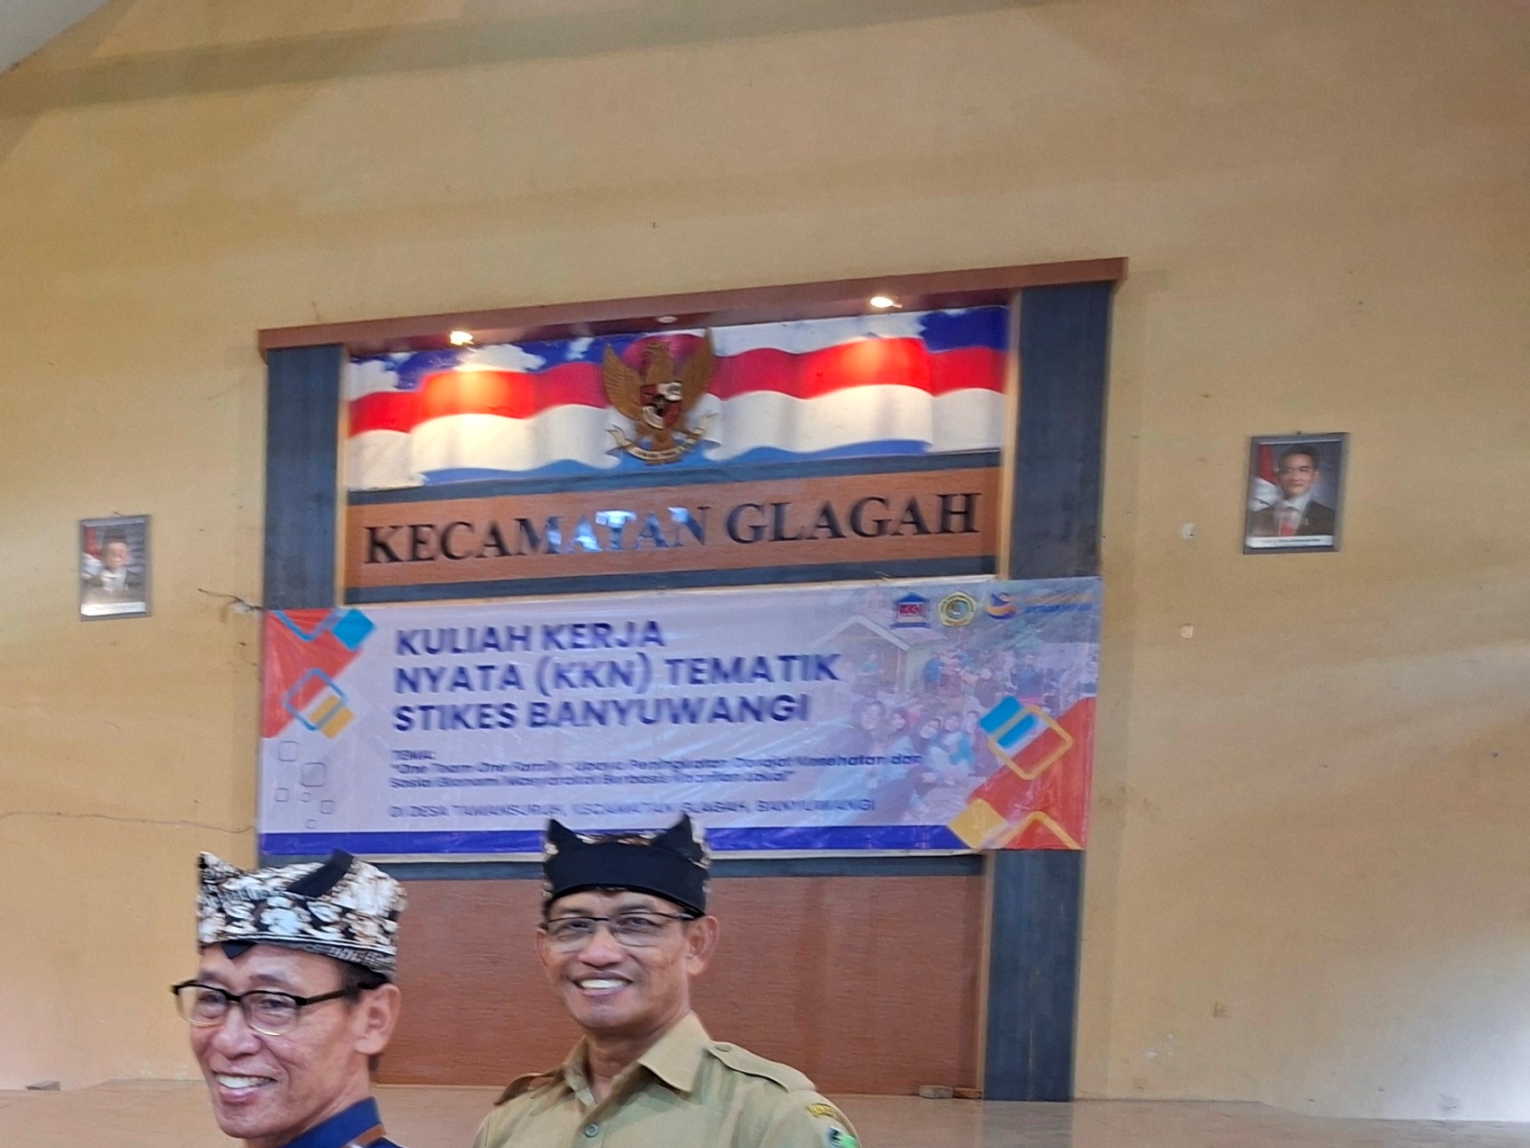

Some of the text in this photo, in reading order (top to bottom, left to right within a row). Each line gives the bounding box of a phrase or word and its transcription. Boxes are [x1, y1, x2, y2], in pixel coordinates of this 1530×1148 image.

[364, 491, 982, 564] KECAMATAN GLAGAH
[396, 620, 666, 656] KULIAH KERJA
[394, 652, 841, 697] NYATA (KKN) TEMATIK
[394, 693, 811, 732] STIKES BANYUWANGI
[796, 754, 886, 767] Kesehatan
[891, 752, 923, 765] dan
